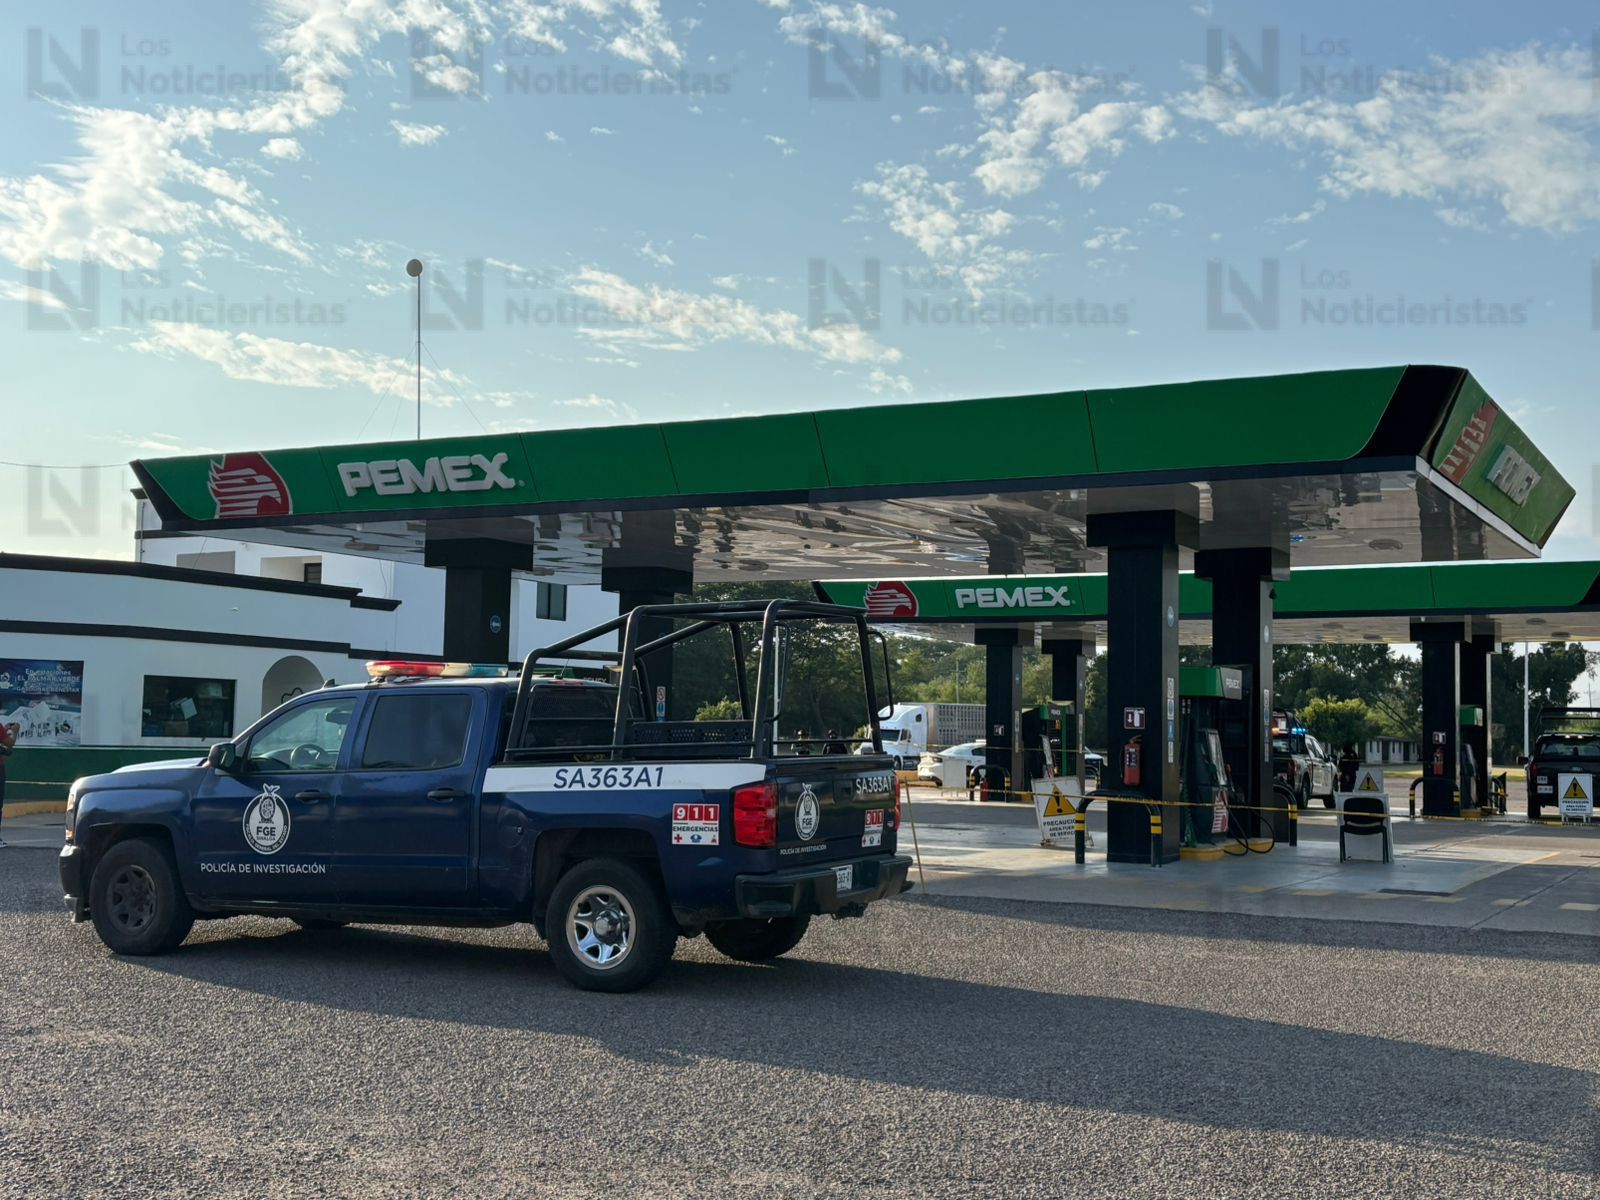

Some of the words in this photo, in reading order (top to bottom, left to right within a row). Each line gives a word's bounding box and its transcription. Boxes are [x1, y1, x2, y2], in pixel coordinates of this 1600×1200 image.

[337, 452, 516, 497] PEMEX
[955, 586, 1071, 608] PEMEX
[553, 766, 664, 789] SA363A1
[856, 776, 892, 794] SA363A1
[676, 807, 715, 820] 911
[802, 817, 813, 827] FGE
[256, 826, 277, 836] FGE
[200, 861, 237, 873] POLICÍA
[238, 863, 252, 873] DE
[253, 861, 326, 874] INVESTIGACIÓN
